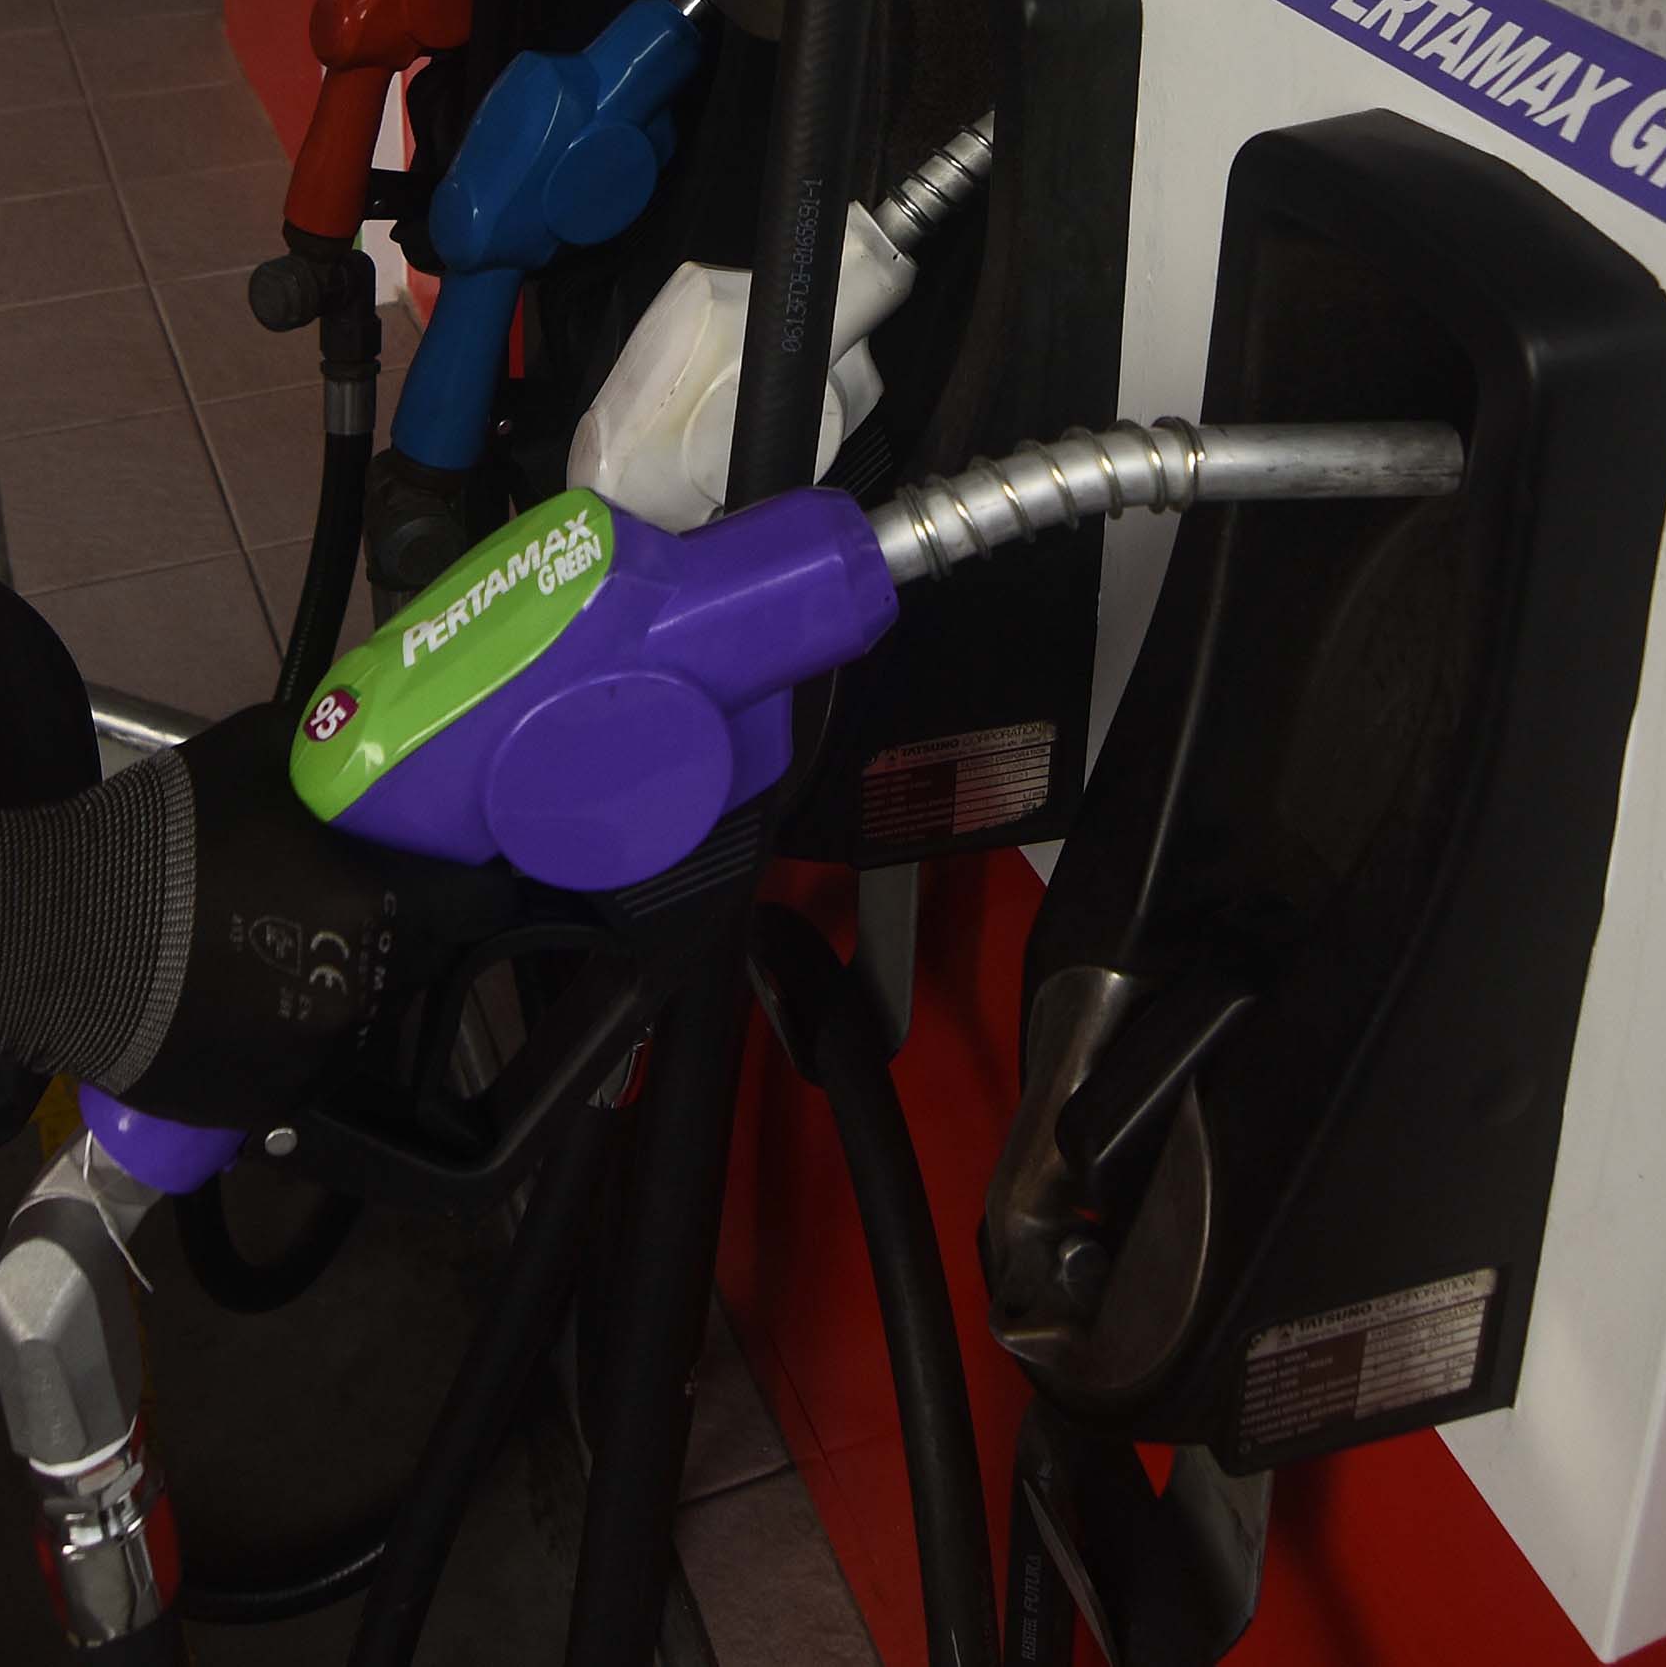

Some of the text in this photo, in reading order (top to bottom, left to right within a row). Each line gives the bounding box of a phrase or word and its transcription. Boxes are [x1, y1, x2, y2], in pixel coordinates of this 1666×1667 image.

[402, 509, 592, 668] PERTAMAX
[538, 534, 601, 595] GREEN
[310, 694, 347, 740] 95
